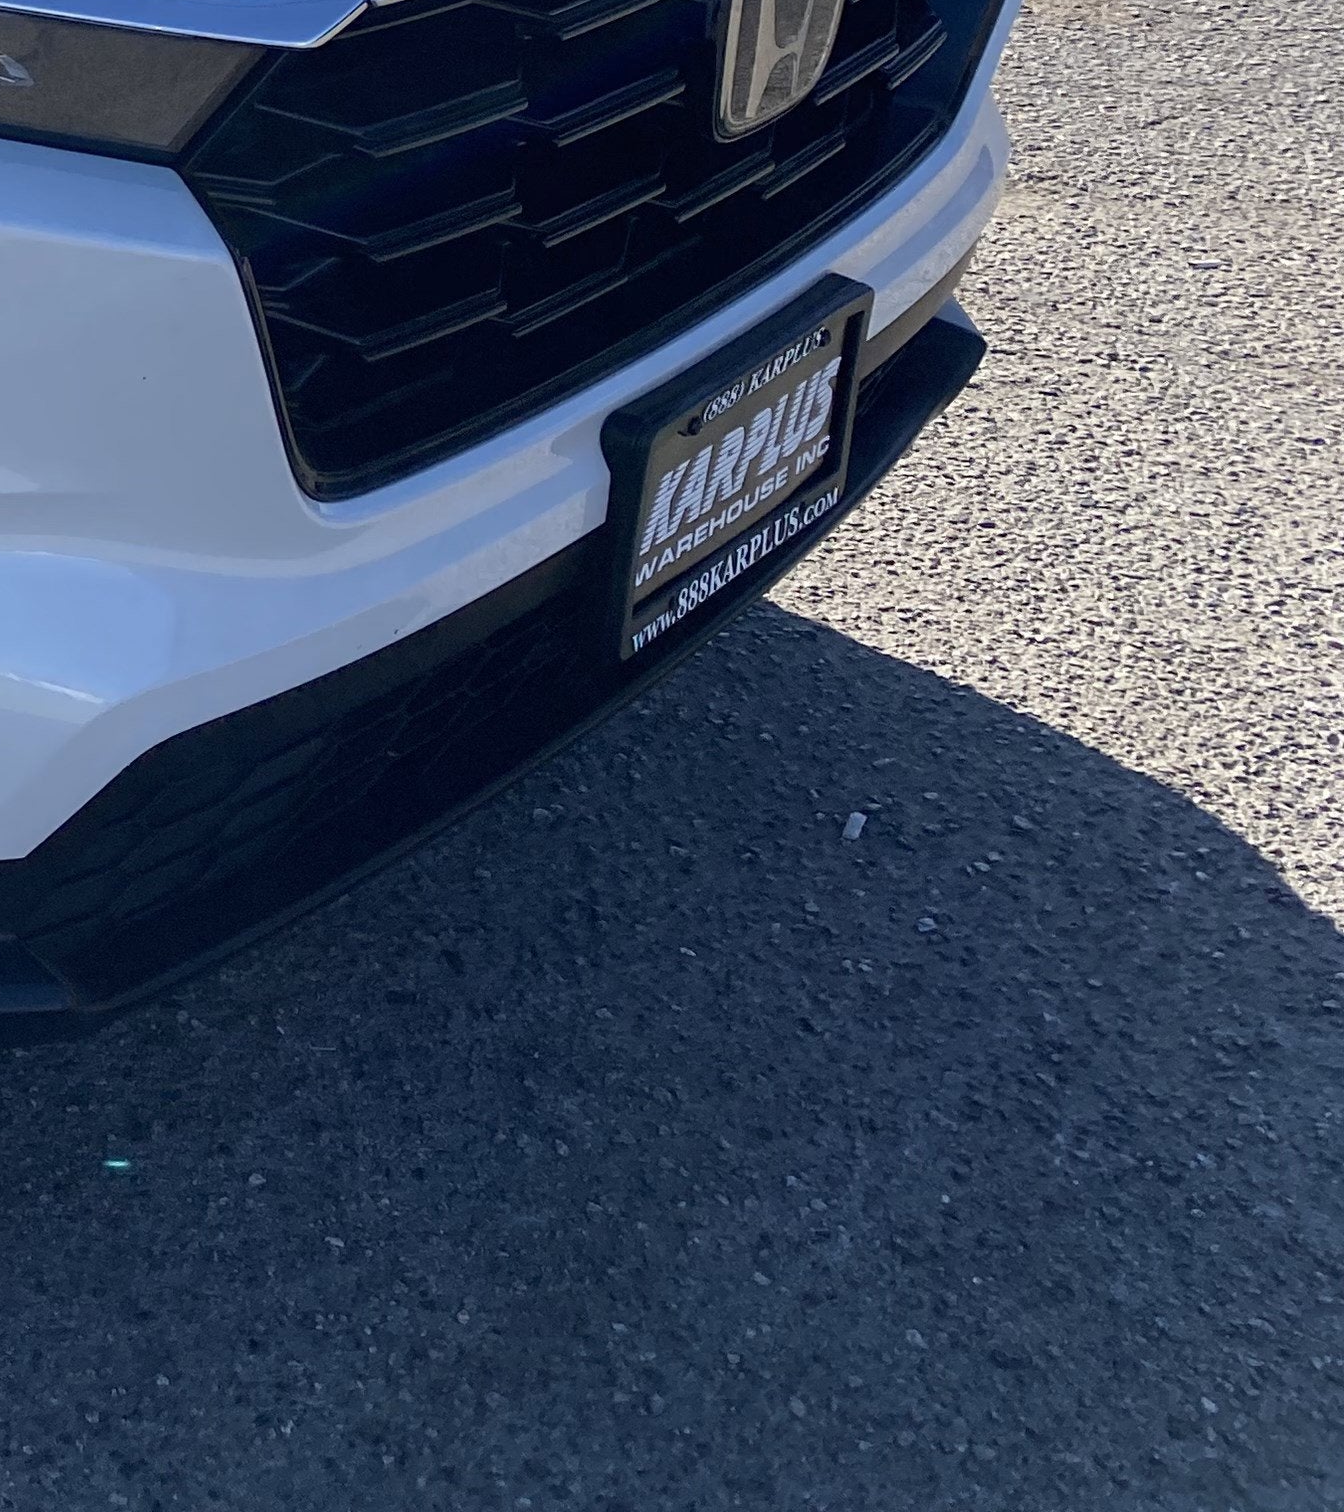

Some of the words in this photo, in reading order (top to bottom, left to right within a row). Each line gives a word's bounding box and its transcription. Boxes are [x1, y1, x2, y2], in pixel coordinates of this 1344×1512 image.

[702, 382, 744, 425] (888)
[748, 327, 825, 395] KARPLUS
[634, 469, 789, 587] WAREHOUSE
[796, 435, 831, 475] INC
[639, 356, 842, 556] KARPLUS
